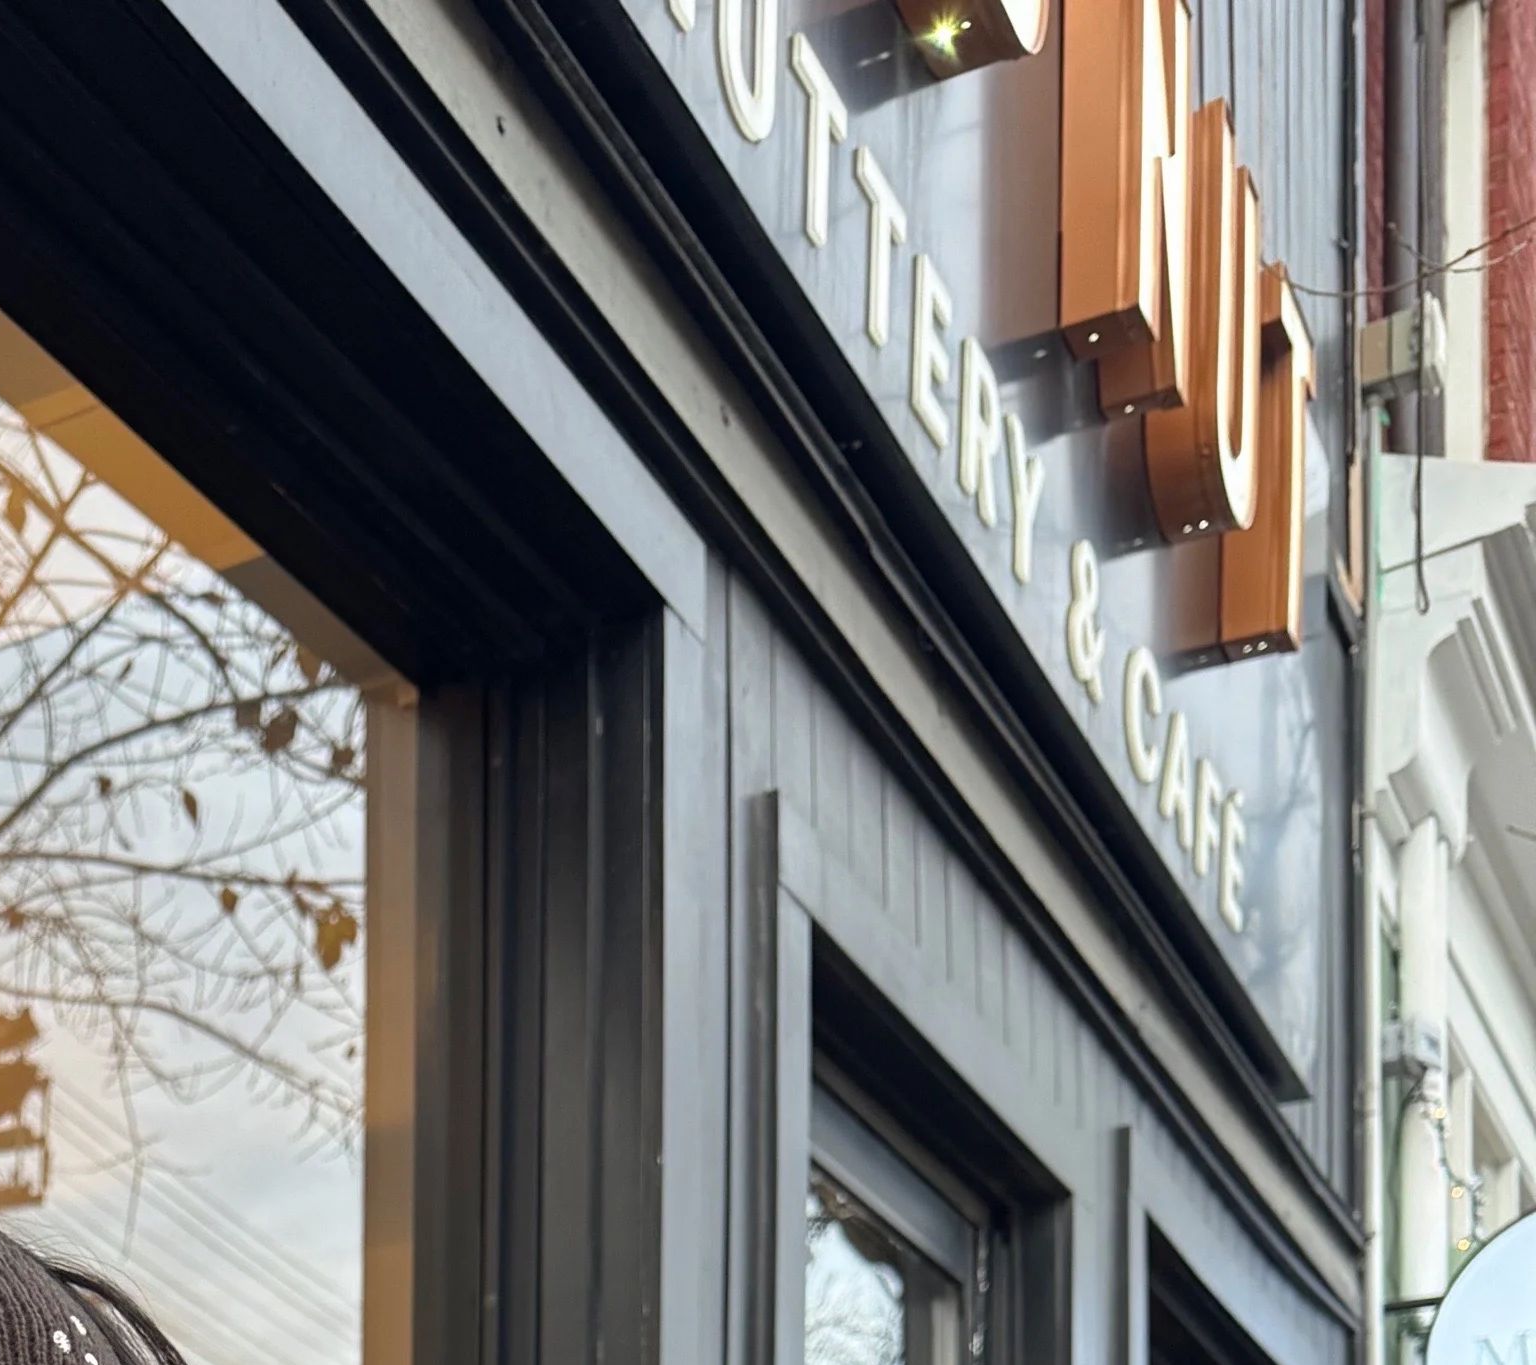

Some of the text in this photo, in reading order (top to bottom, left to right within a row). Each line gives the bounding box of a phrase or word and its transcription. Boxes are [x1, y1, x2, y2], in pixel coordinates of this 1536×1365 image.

[666, 0, 1043, 584] UTTERY
[1066, 538, 1105, 704] &
[1064, 0, 1316, 655] NUT
